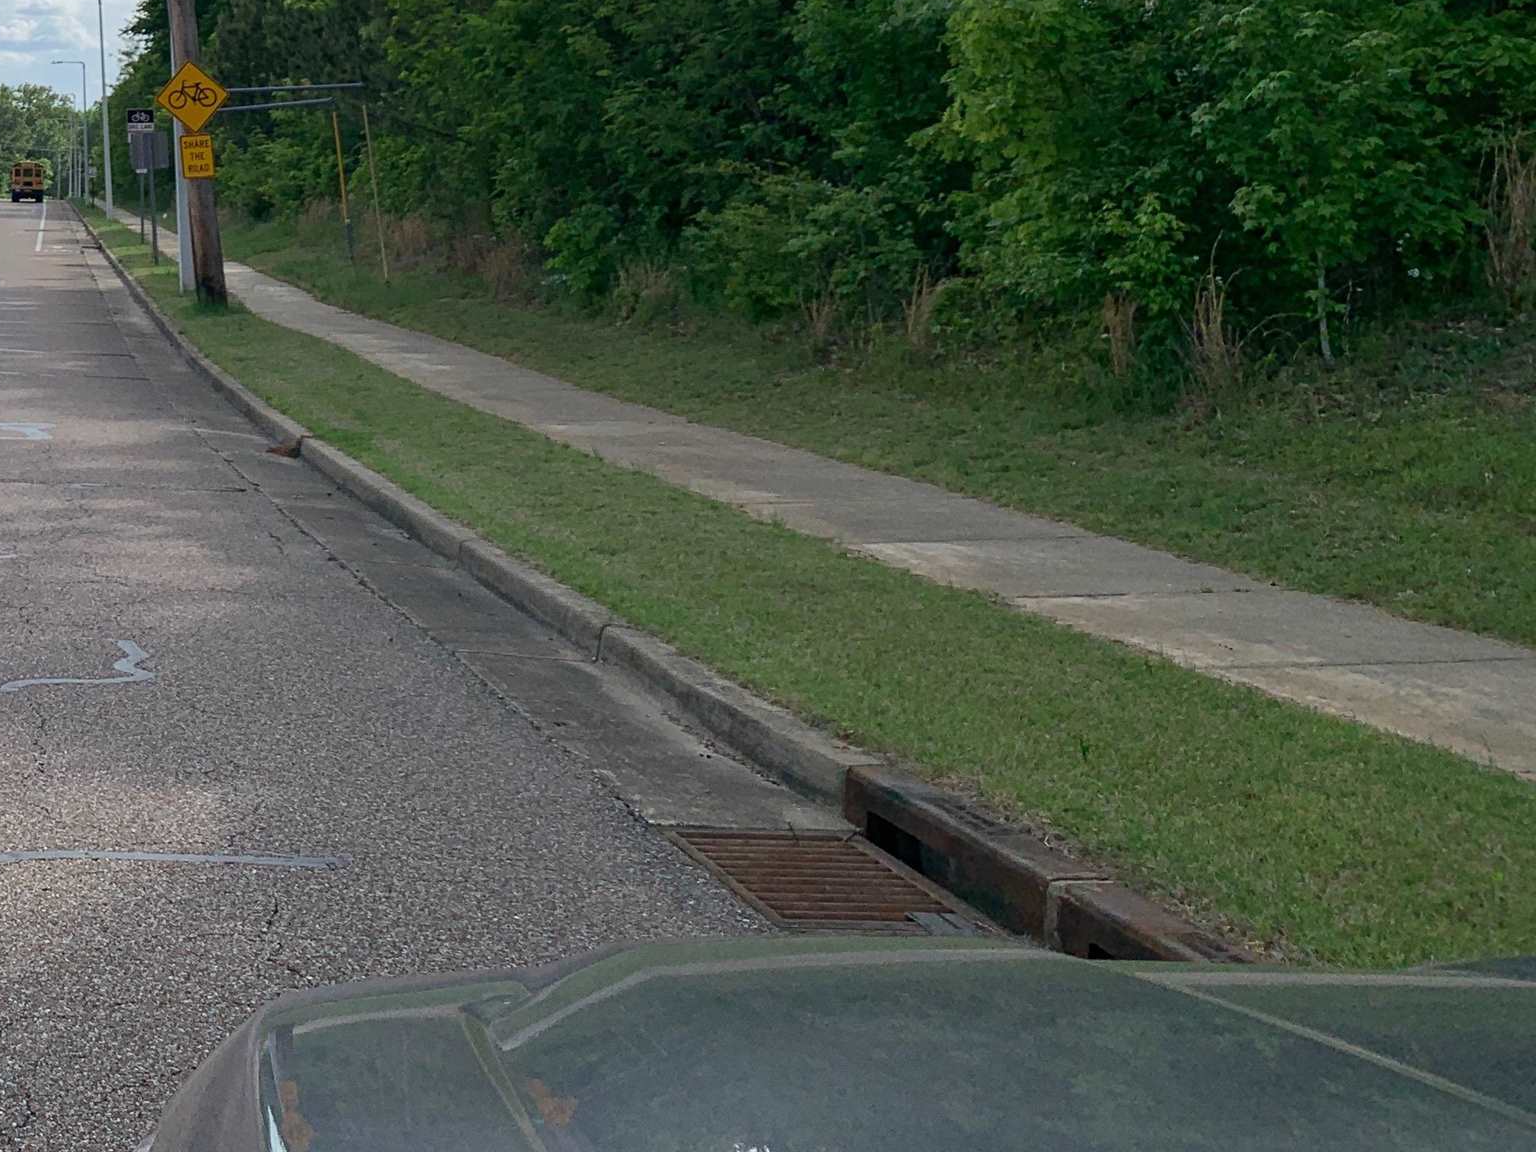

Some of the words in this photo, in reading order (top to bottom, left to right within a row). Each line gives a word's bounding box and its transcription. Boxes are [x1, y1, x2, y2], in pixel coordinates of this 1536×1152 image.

[183, 139, 209, 149] SHARE
[190, 151, 205, 161] THE
[188, 163, 209, 173] ROAD
